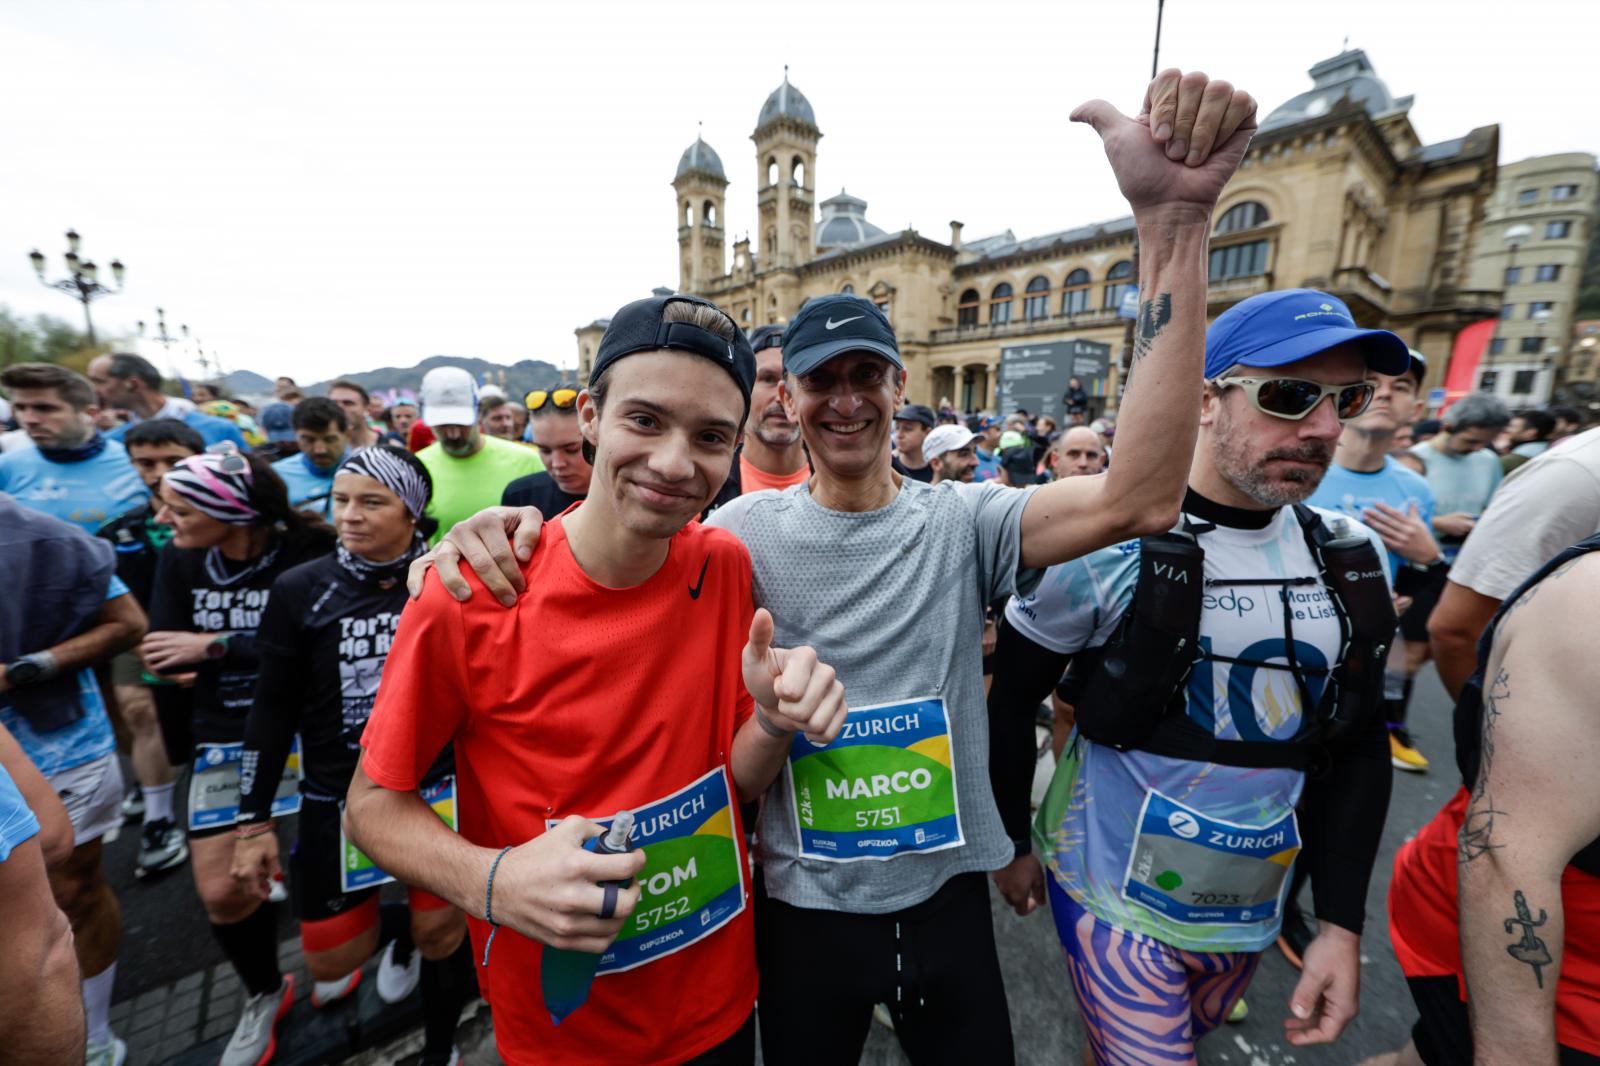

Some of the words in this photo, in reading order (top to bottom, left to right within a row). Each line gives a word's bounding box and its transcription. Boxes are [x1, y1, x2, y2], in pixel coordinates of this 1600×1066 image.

[1203, 588, 1254, 617] edp
[1309, 607, 1337, 620] Lisb
[193, 610, 225, 631] de
[229, 608, 265, 629] Ru
[338, 637, 370, 660] de
[842, 713, 920, 740] ZURICH
[825, 768, 932, 801] MARCO
[629, 794, 706, 842] ZURICH
[856, 806, 901, 828] 5751
[857, 838, 899, 848] GIPUZKOA
[1208, 831, 1284, 849] ZURICH
[638, 856, 698, 901] TOM
[1192, 892, 1241, 905] 7023
[636, 896, 691, 931] 5752
